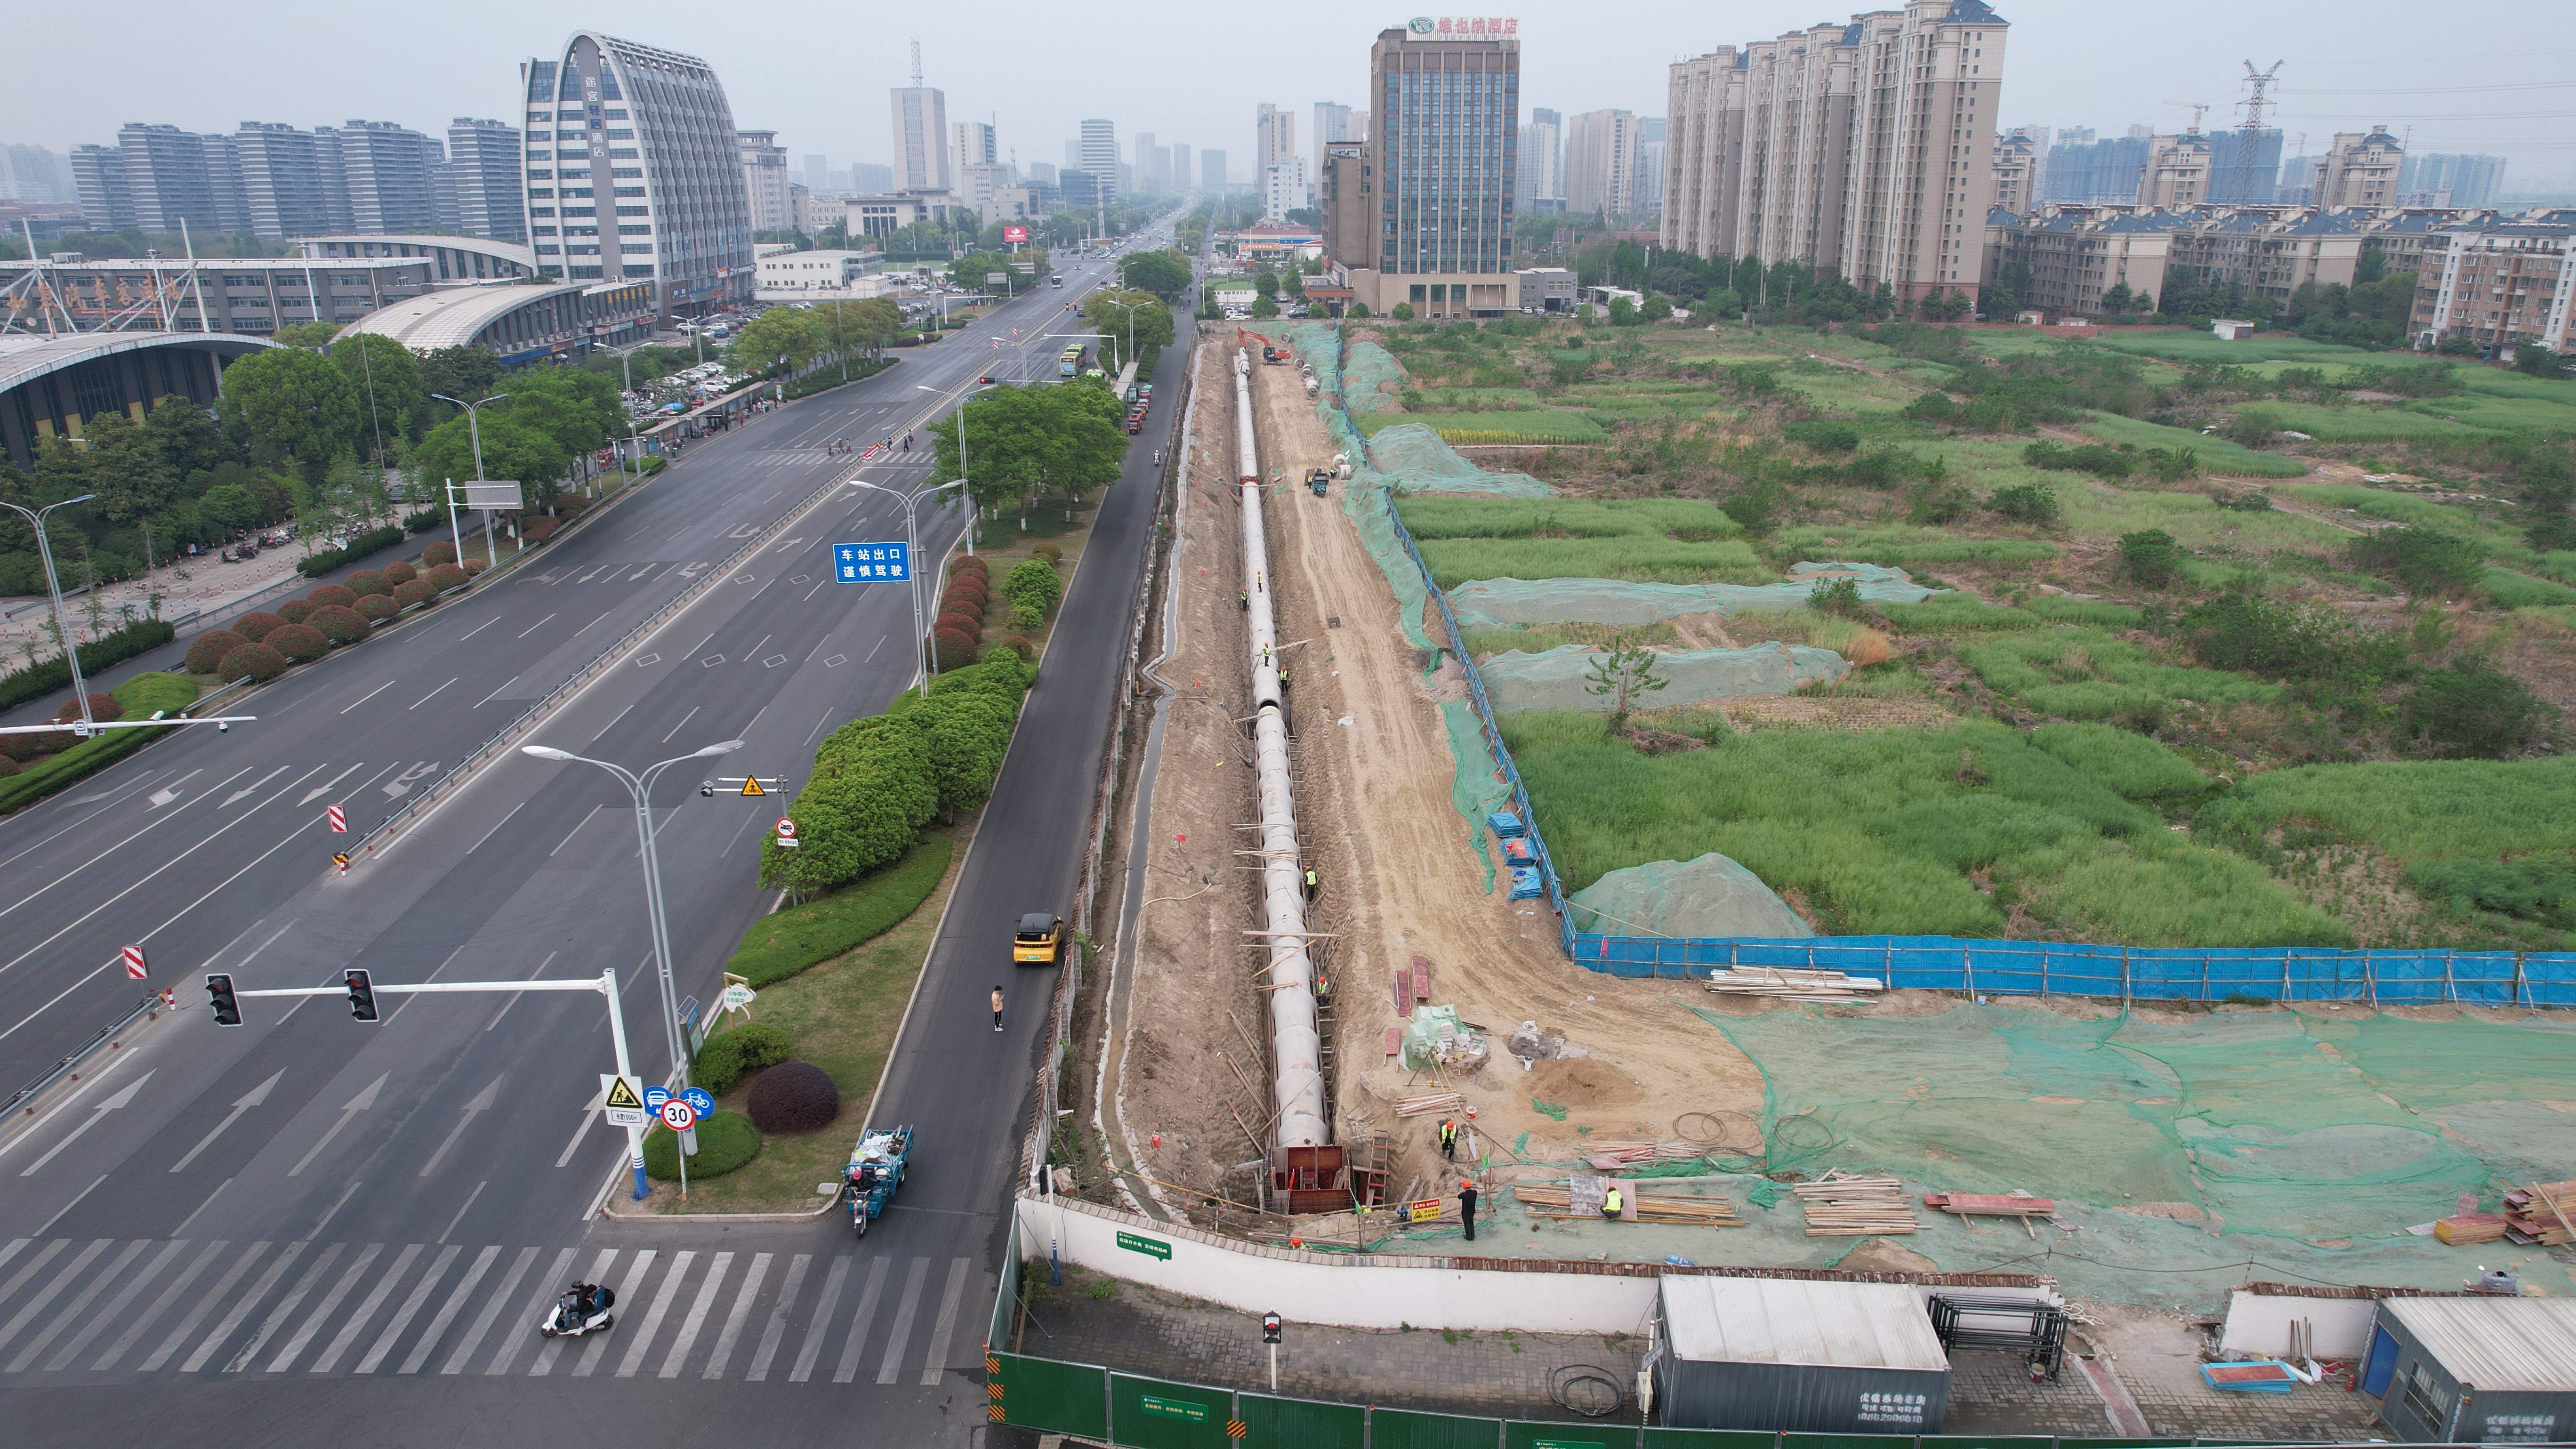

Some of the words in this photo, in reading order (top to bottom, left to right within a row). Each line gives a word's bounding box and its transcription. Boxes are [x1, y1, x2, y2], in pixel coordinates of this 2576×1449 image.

[1438, 17, 1518, 34] 维也纳酒店
[585, 77, 604, 157] 途客轻居酒店
[841, 548, 900, 561] 车站出口
[843, 564, 903, 578] 谨慎驾驶
[668, 1108, 687, 1122] 30
